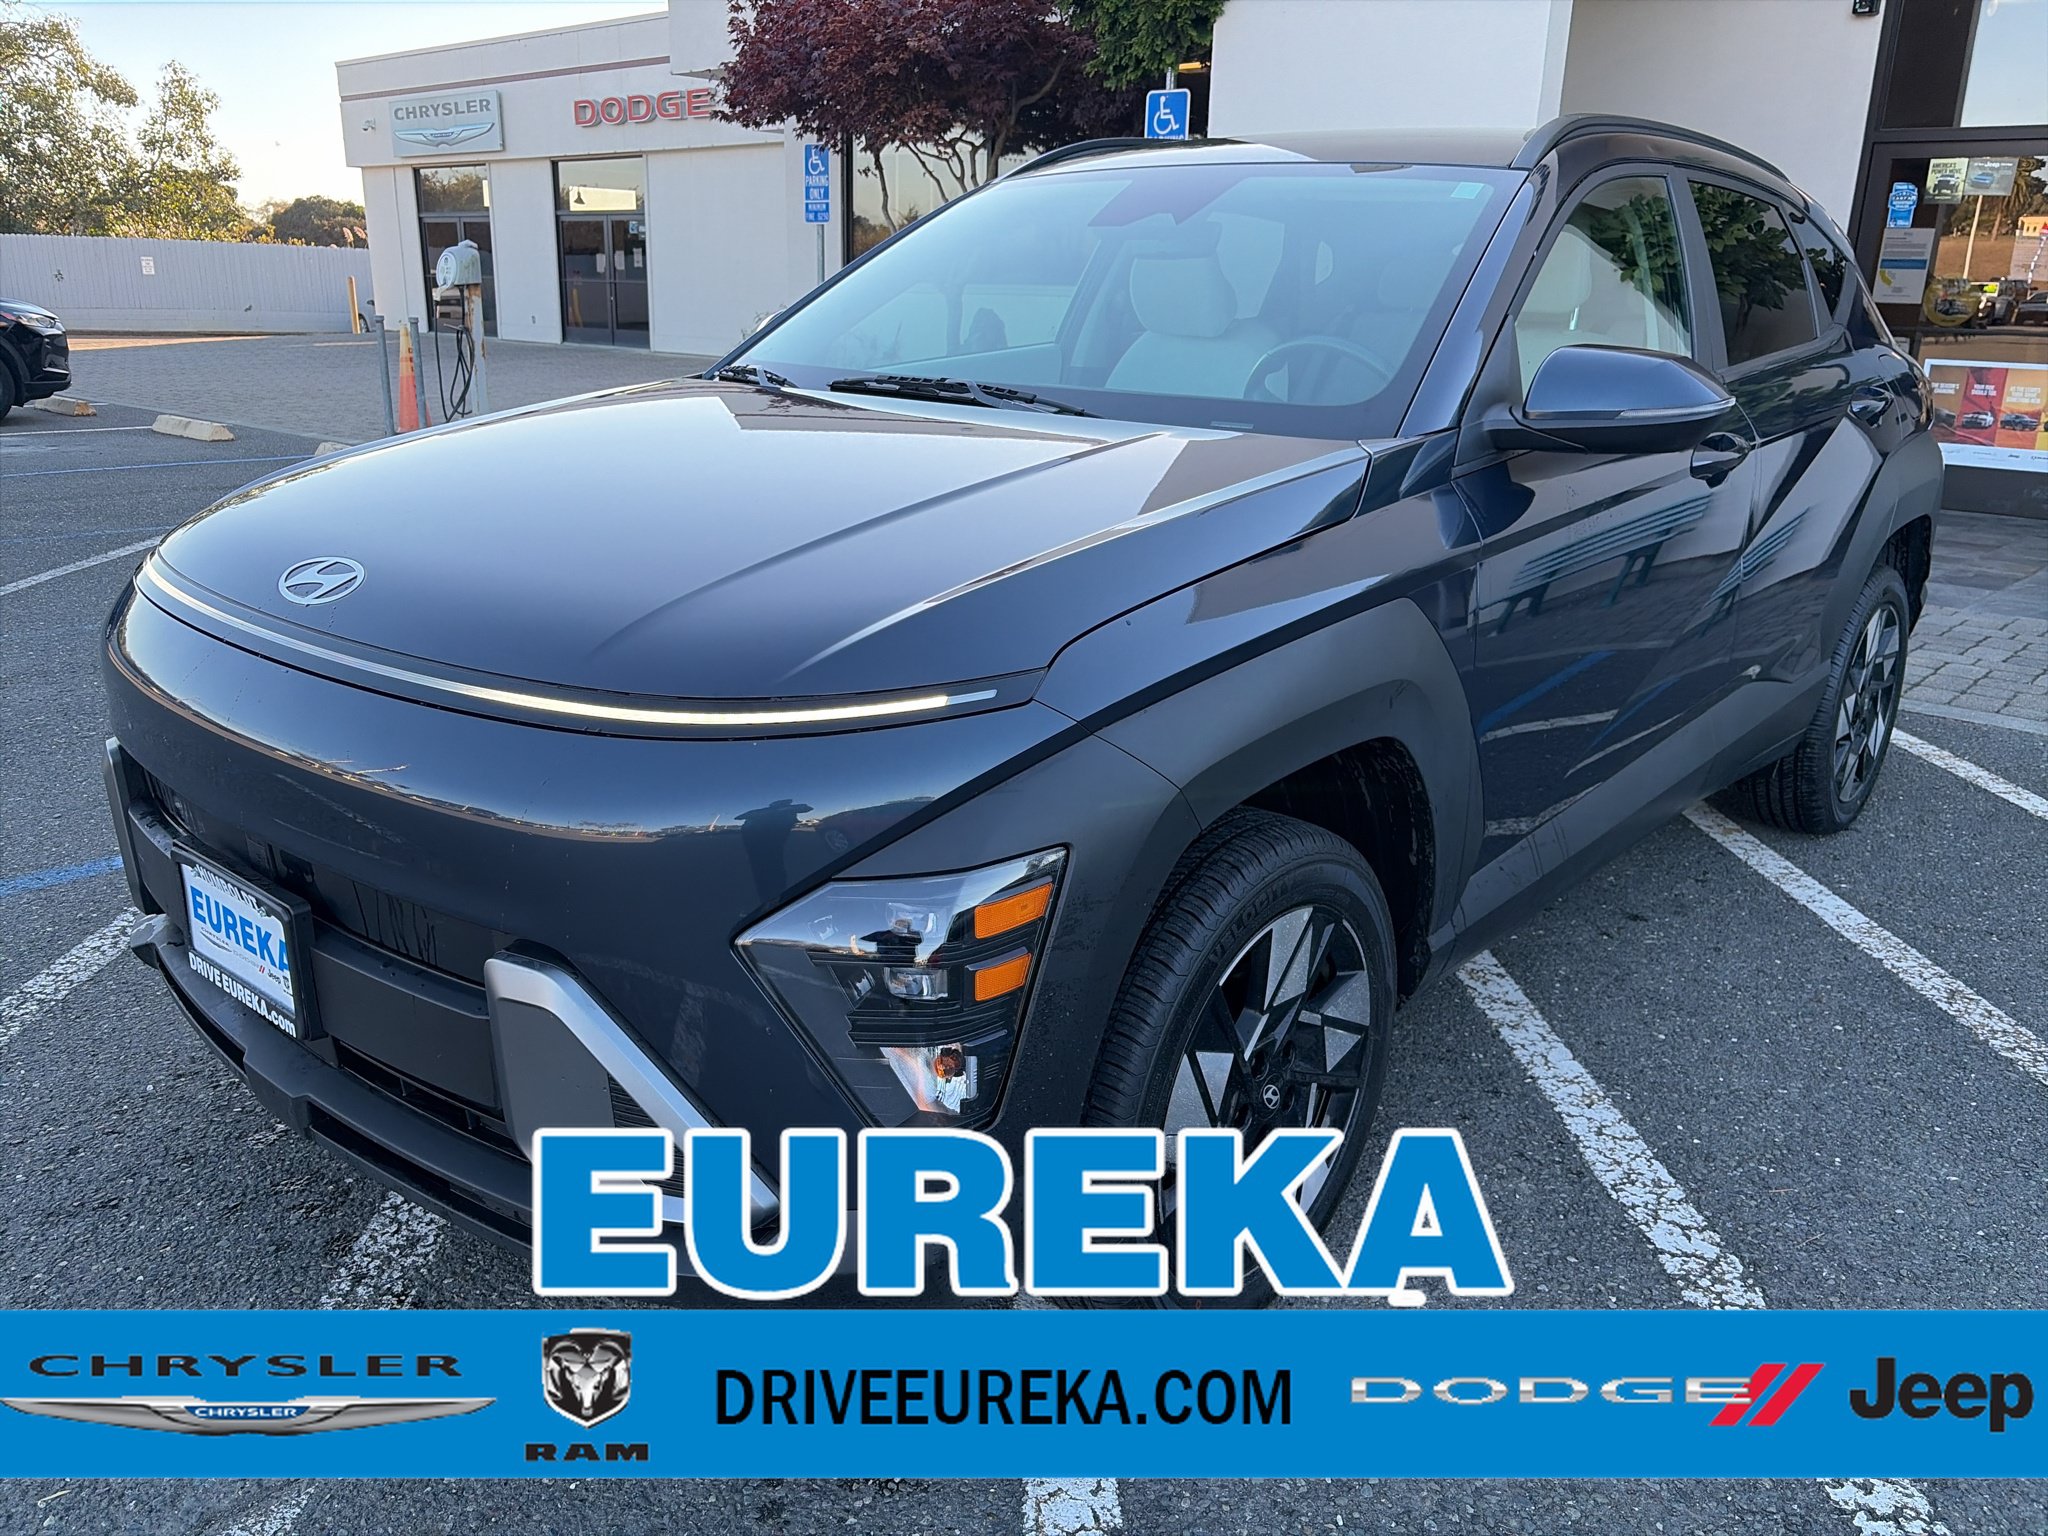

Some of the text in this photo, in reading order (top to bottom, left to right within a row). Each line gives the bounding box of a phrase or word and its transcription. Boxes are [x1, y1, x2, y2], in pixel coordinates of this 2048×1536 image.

[394, 99, 491, 120] CHRYSLER
[574, 88, 712, 126] DODGE
[806, 175, 829, 187] PARKING
[809, 188, 825, 200] ONLY
